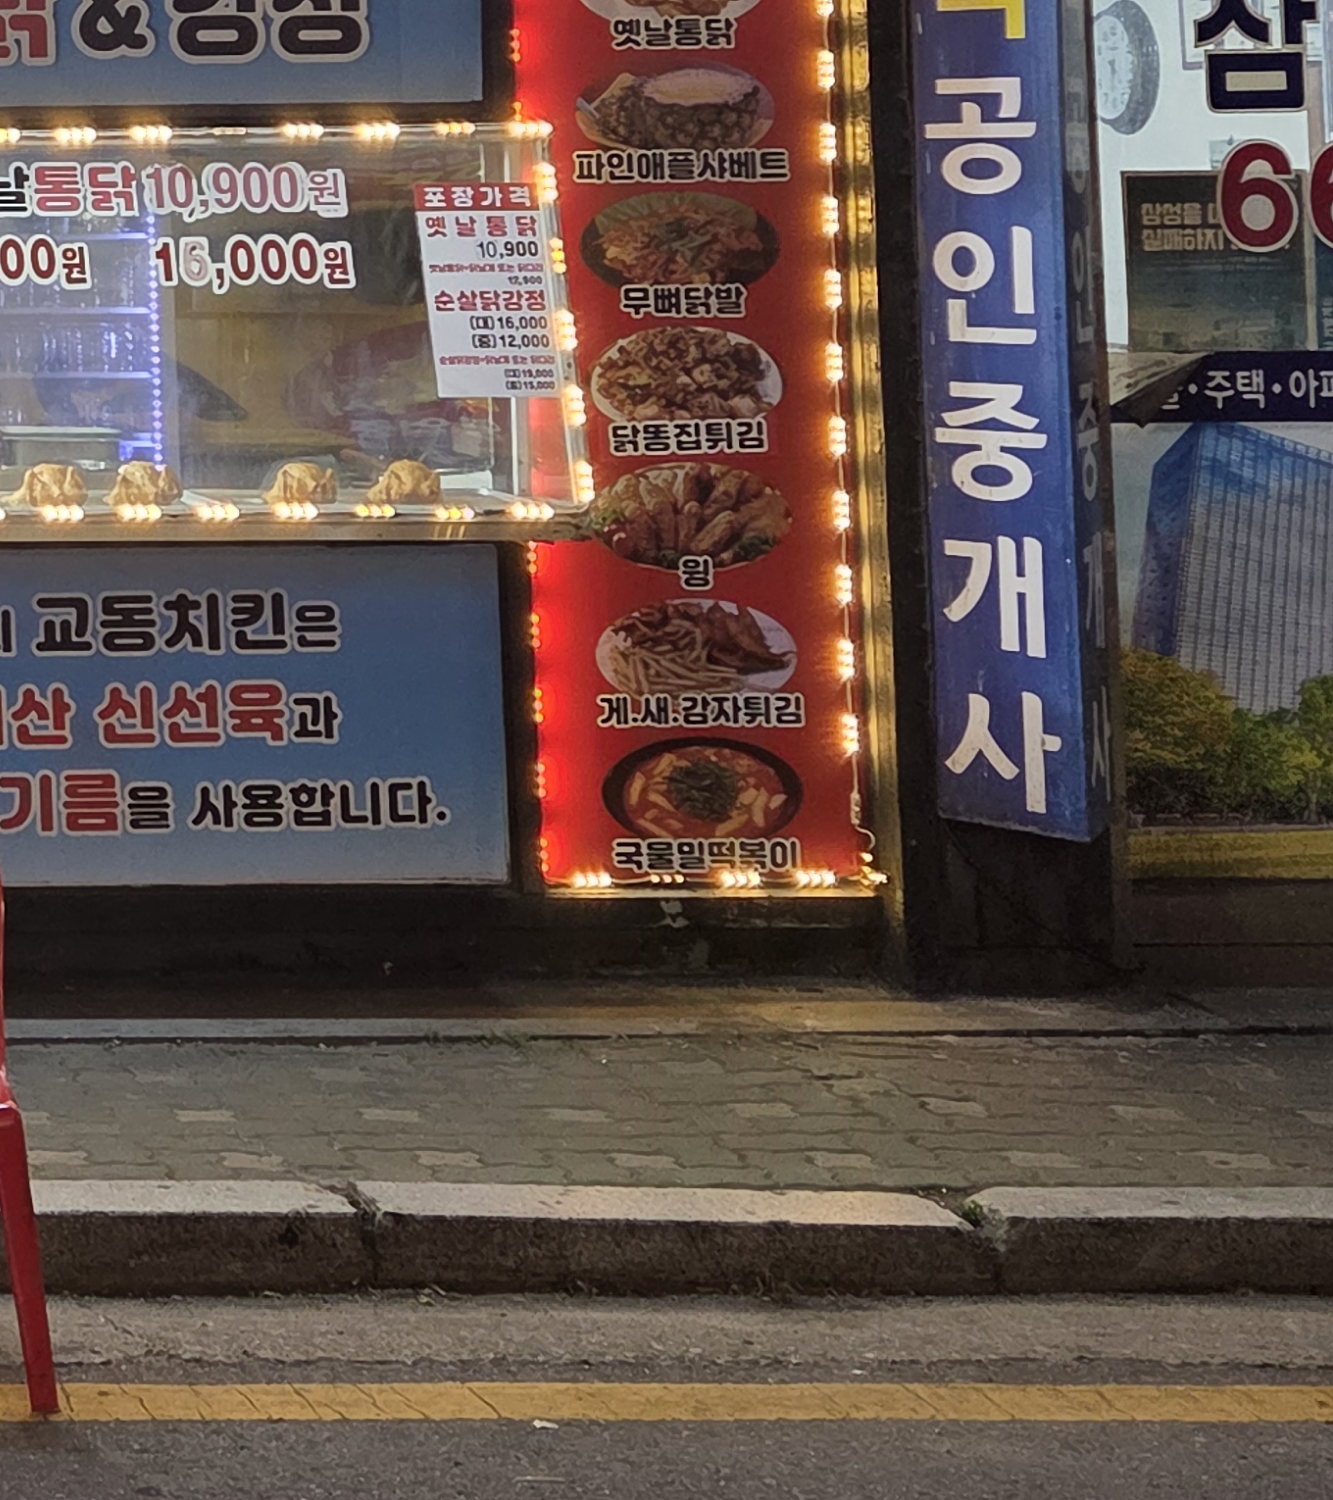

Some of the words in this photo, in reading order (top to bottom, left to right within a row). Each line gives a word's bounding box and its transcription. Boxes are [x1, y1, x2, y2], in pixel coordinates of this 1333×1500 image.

[610, 17, 738, 50] 옛날통닭
[572, 148, 791, 184] 파인애플샤베트
[423, 186, 532, 207] 포장가격
[476, 241, 539, 259] 10,900
[434, 289, 547, 312] 순살닭강정
[620, 284, 747, 318] 무뼈닭발
[610, 419, 768, 456] 닭똥집튀김
[678, 556, 714, 590] 윙
[33, 589, 340, 657] 교동치킨은
[98, 682, 340, 748] 신선육과
[190, 778, 451, 831] 사용합니다.
[611, 838, 801, 874] 국물밀떡볶이
